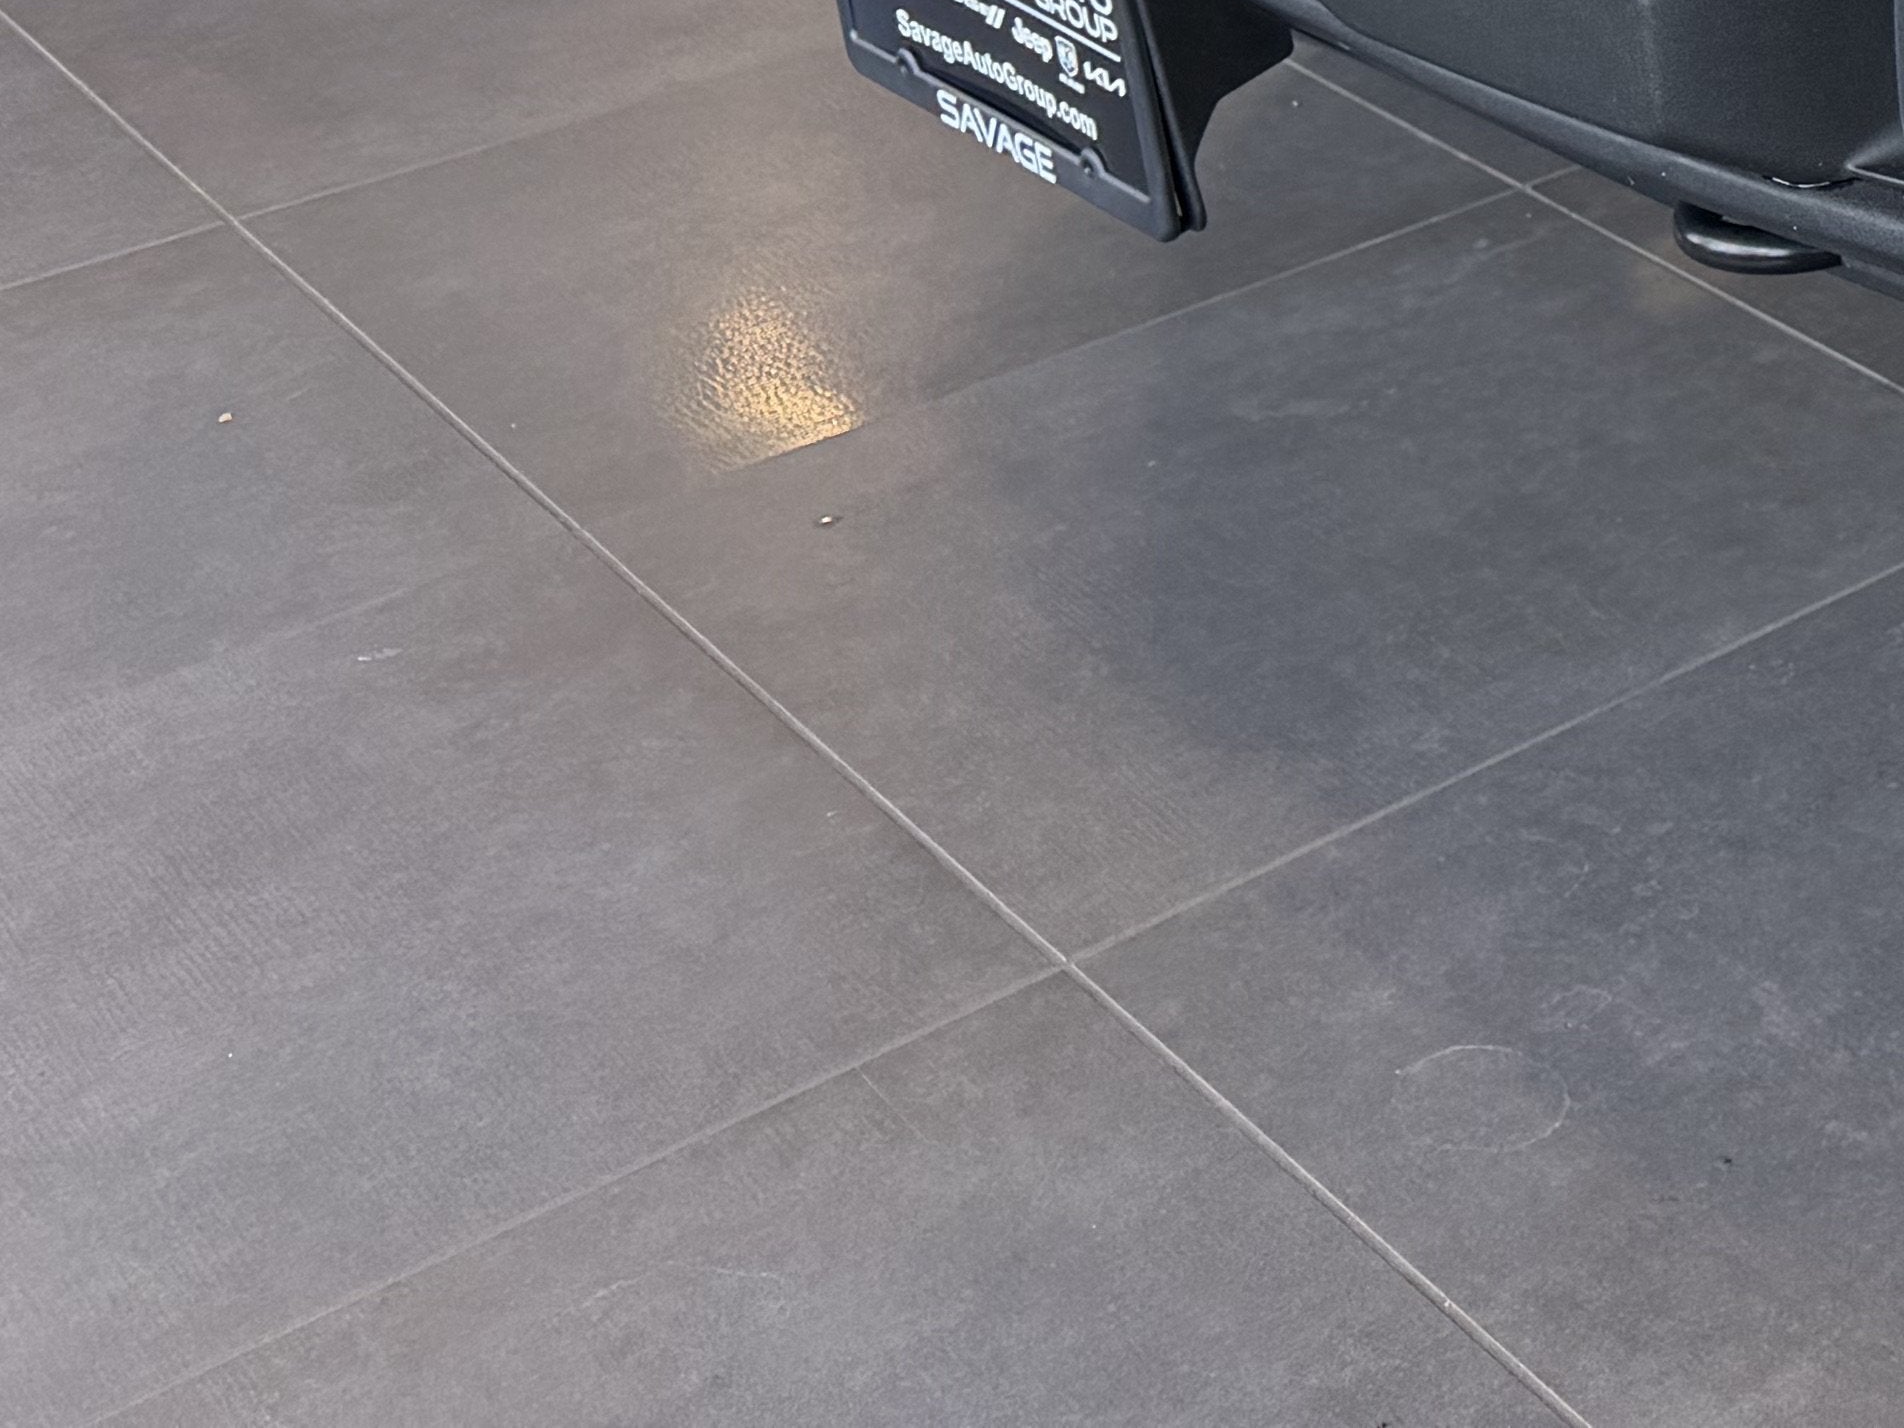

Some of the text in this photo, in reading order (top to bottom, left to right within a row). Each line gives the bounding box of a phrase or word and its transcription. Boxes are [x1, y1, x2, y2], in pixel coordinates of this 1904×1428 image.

[896, 8, 1098, 140] SavageAutoGroup.com
[1011, 16, 1053, 63] Jeep
[936, 88, 1058, 184] SAVAGE
